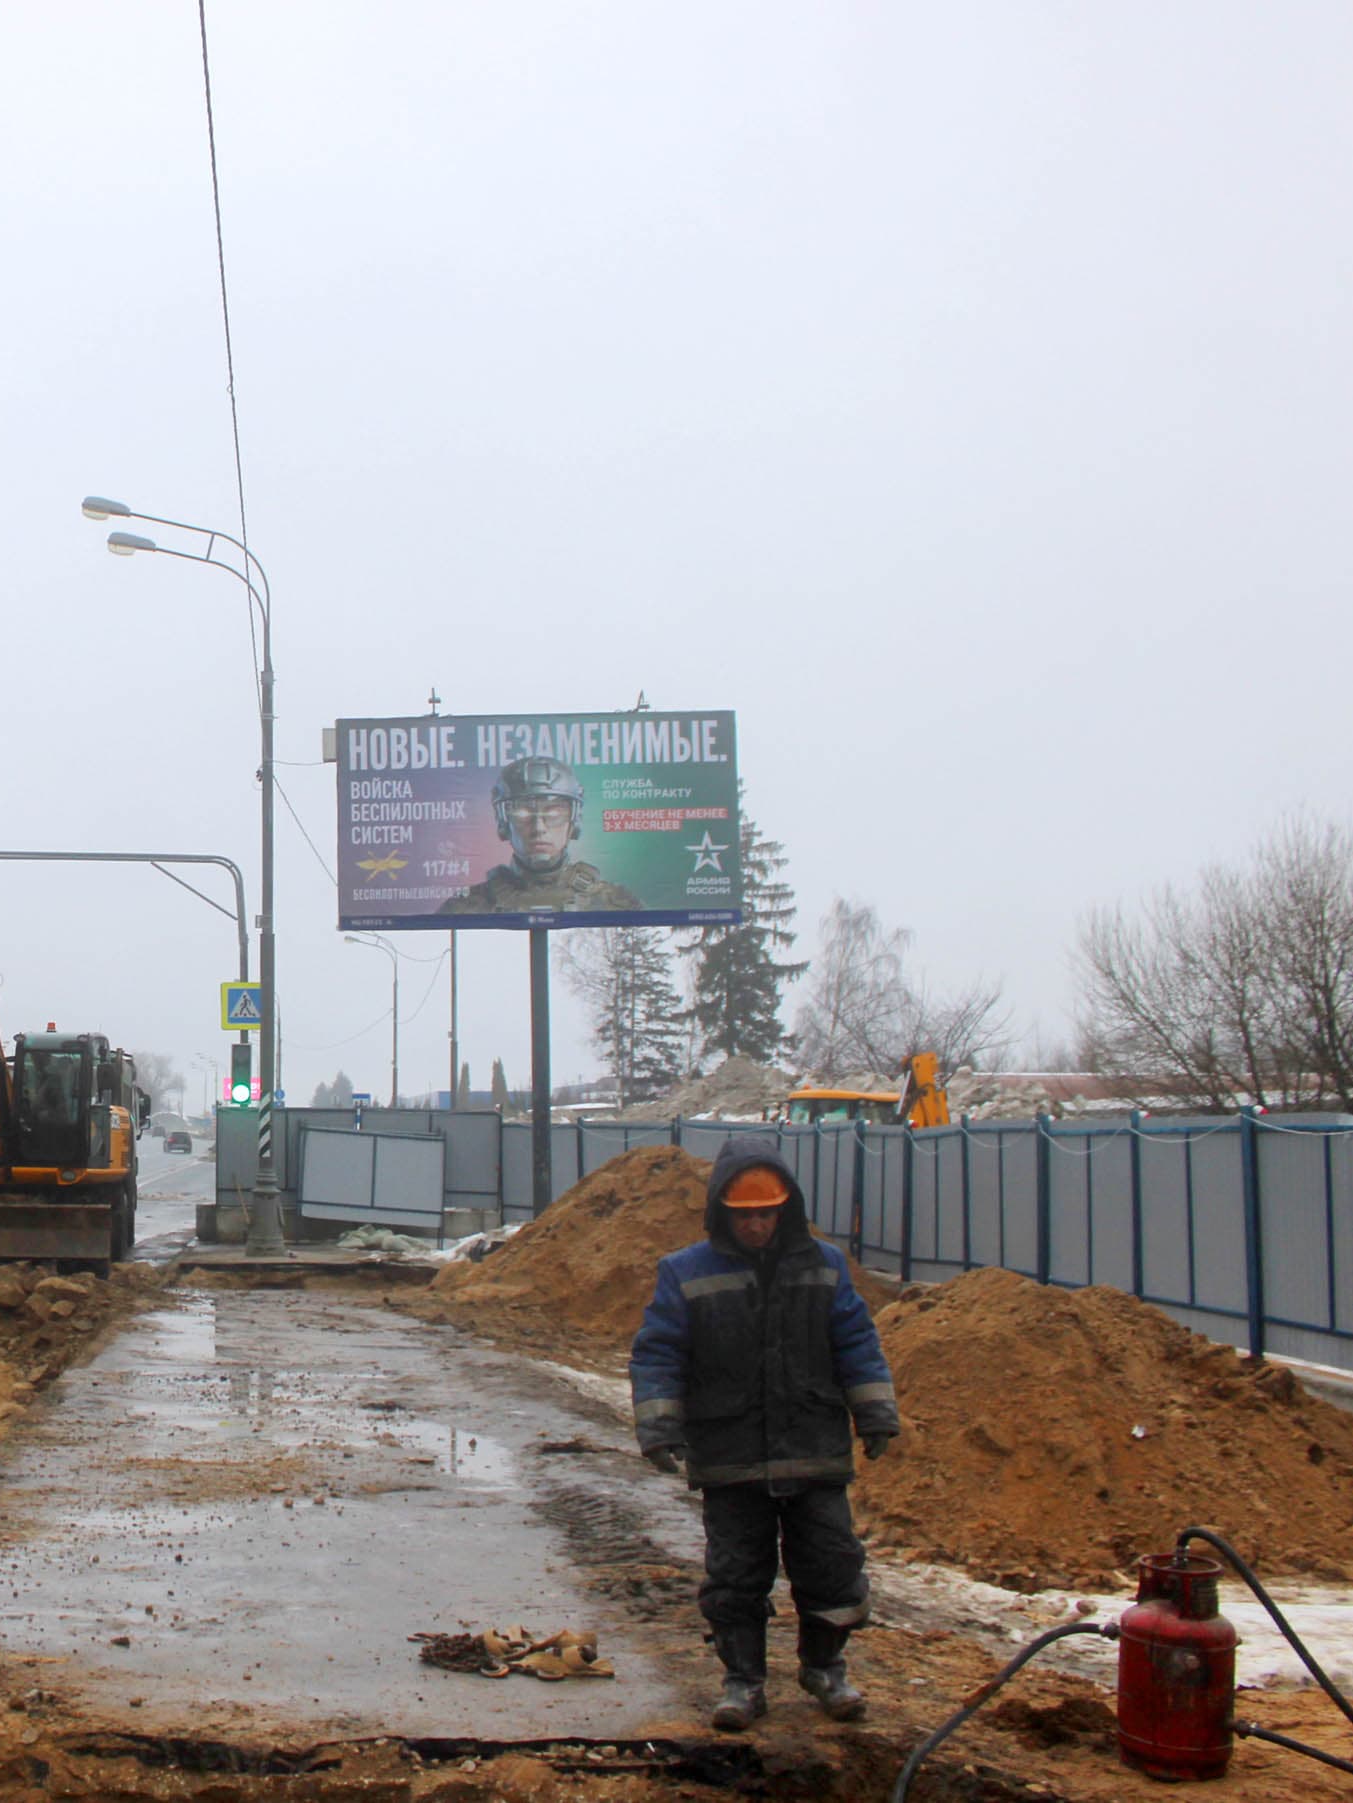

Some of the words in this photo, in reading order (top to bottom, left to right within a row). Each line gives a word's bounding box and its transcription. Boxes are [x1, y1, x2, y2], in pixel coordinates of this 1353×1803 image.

[349, 727, 464, 771] НОВЫЕ.
[477, 720, 728, 767] НЕЗАМЕНИМЫЕ.
[350, 778, 413, 799] ВОЙСКА
[602, 779, 653, 789] СЛУЖБА
[603, 790, 620, 799] ПО
[622, 788, 692, 799] КОНТРАКТУ
[351, 801, 466, 822] БЕСПИЛОТНЫХ
[603, 810, 665, 820] ОБУЧЕНИЕ
[668, 809, 683, 819] НЕ
[685, 808, 726, 818] МЕНЕЕ
[624, 820, 680, 831] МЕСЯЦЕВ
[351, 825, 413, 844] СИСТЕМ
[687, 877, 730, 885] АРМИЯ
[686, 887, 730, 895] РОССИИ
